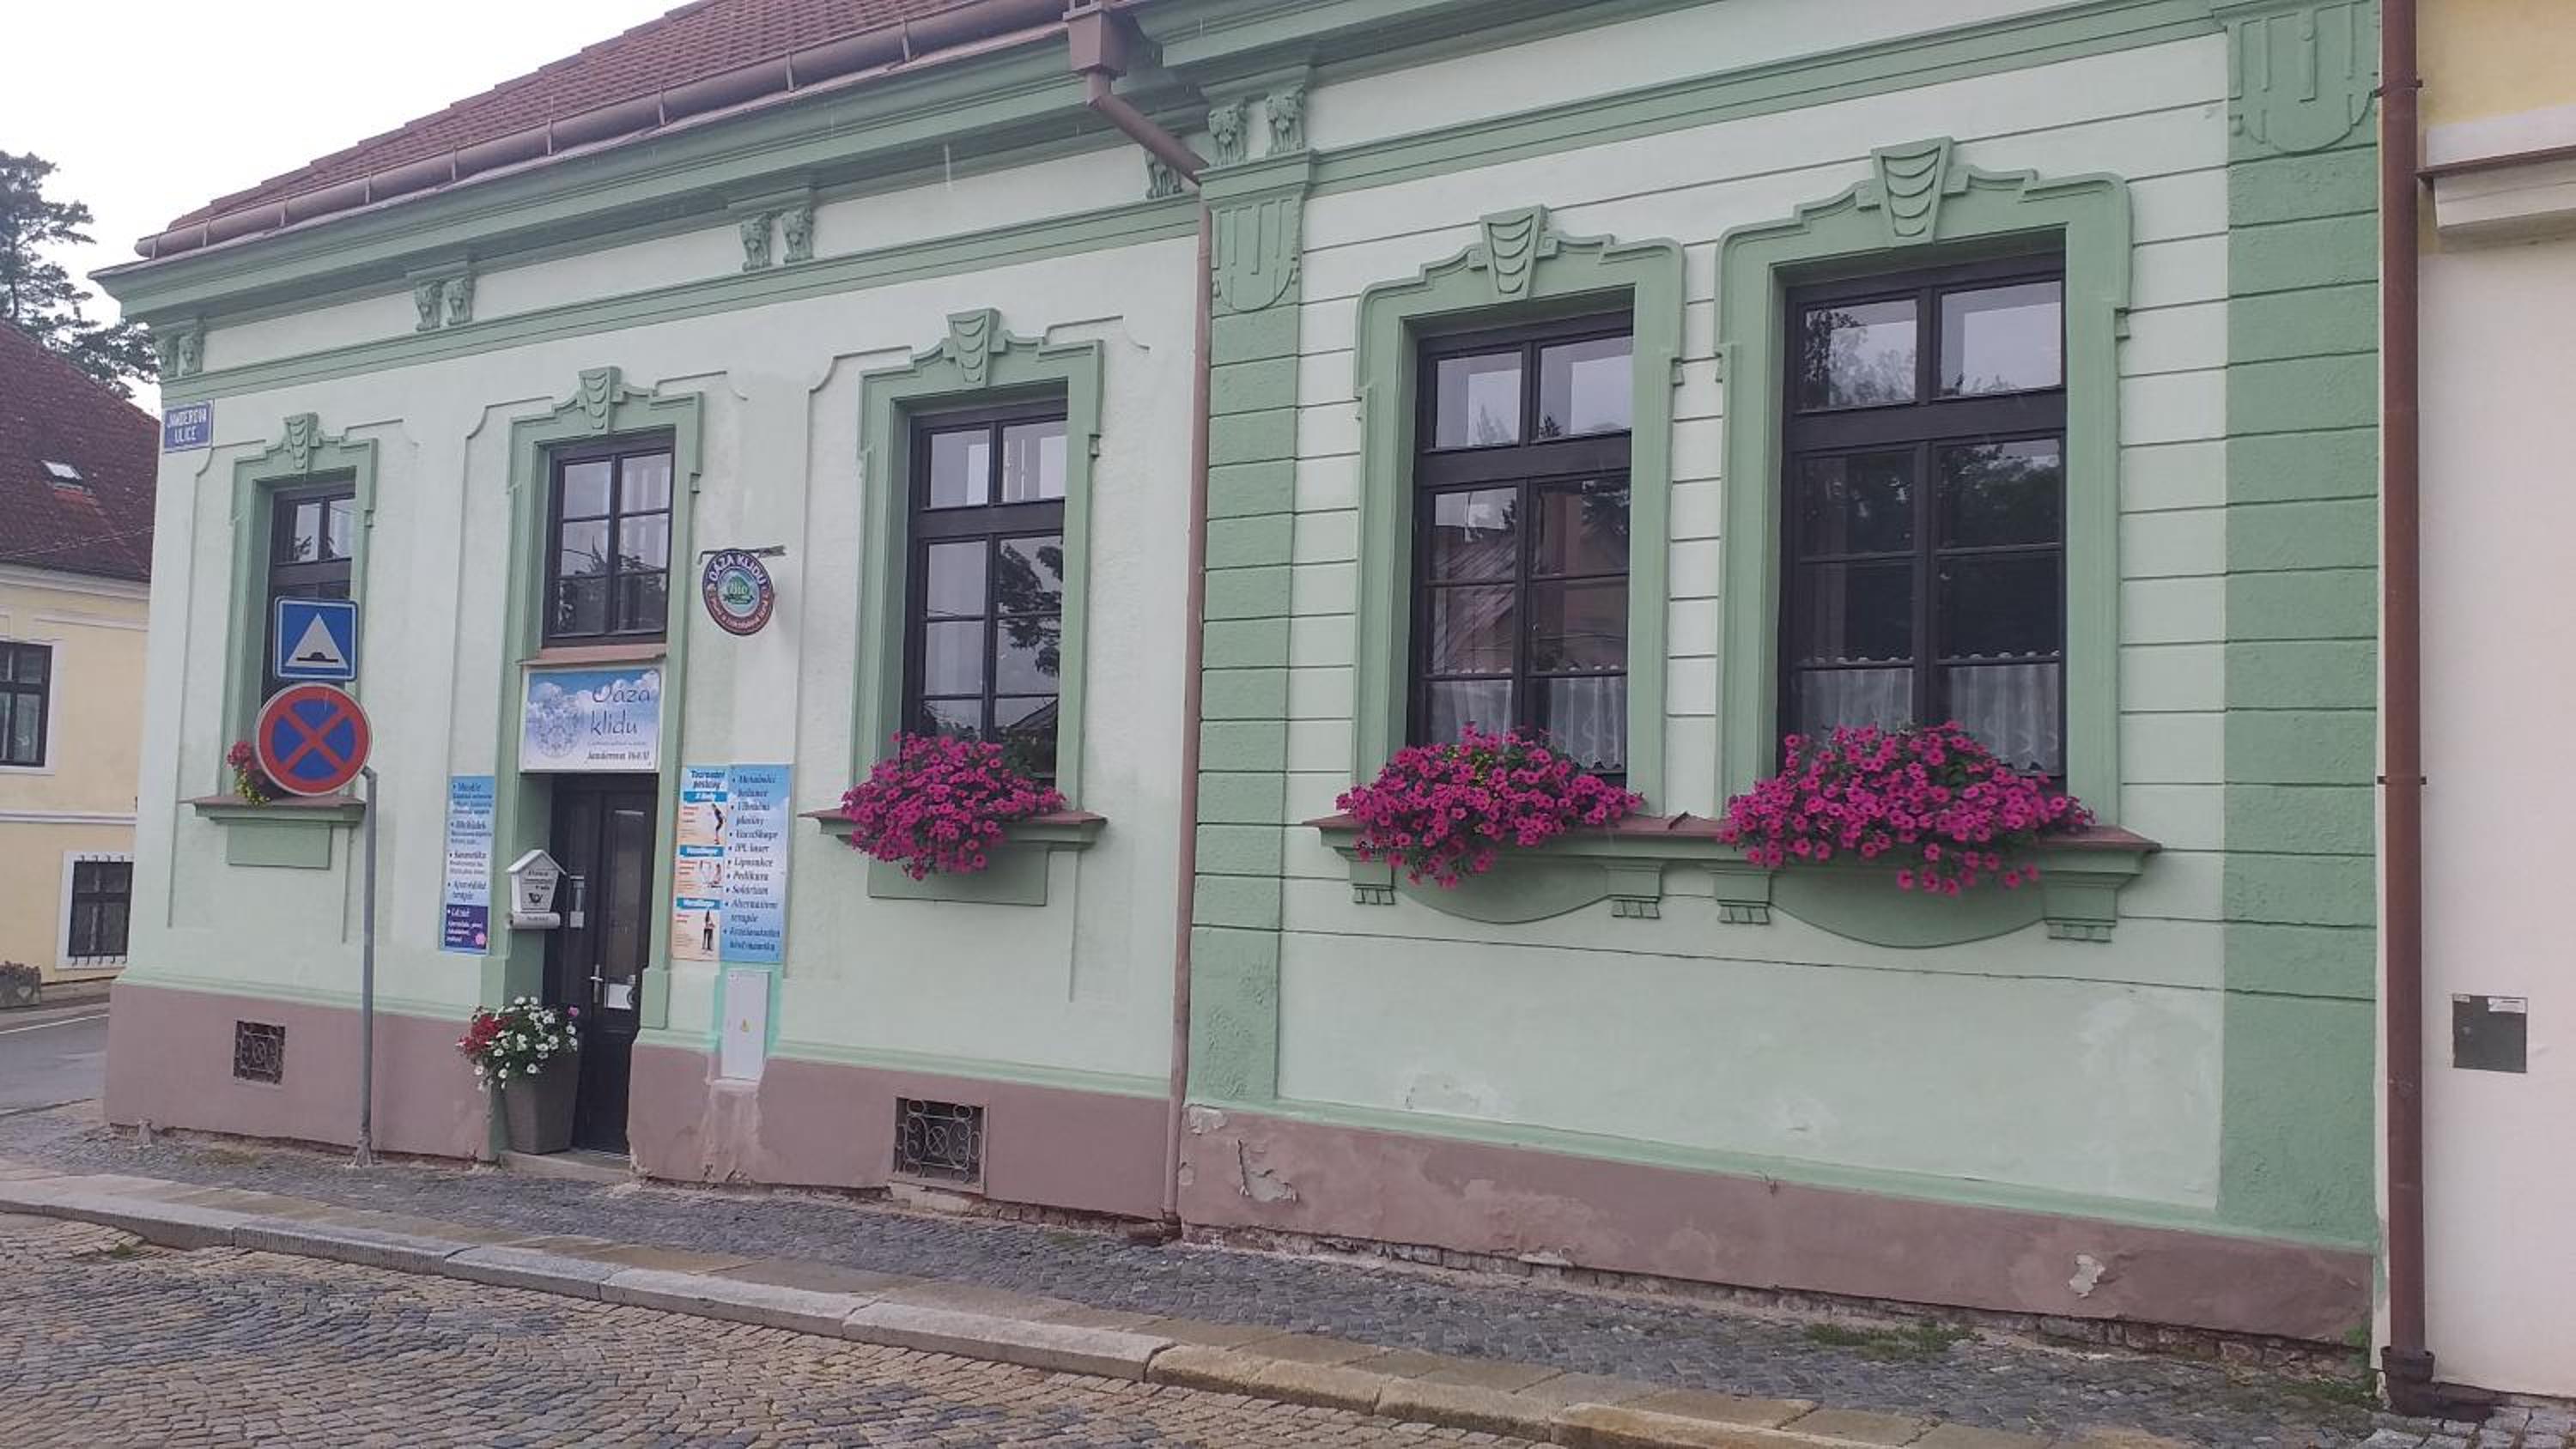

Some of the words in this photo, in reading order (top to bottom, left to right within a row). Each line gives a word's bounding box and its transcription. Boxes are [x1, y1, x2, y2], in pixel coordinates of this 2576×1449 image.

[174, 426, 197, 443] ULICE
[737, 555, 767, 585] KLIDU
[592, 684, 651, 704] Oáza
[590, 709, 638, 736] klidu
